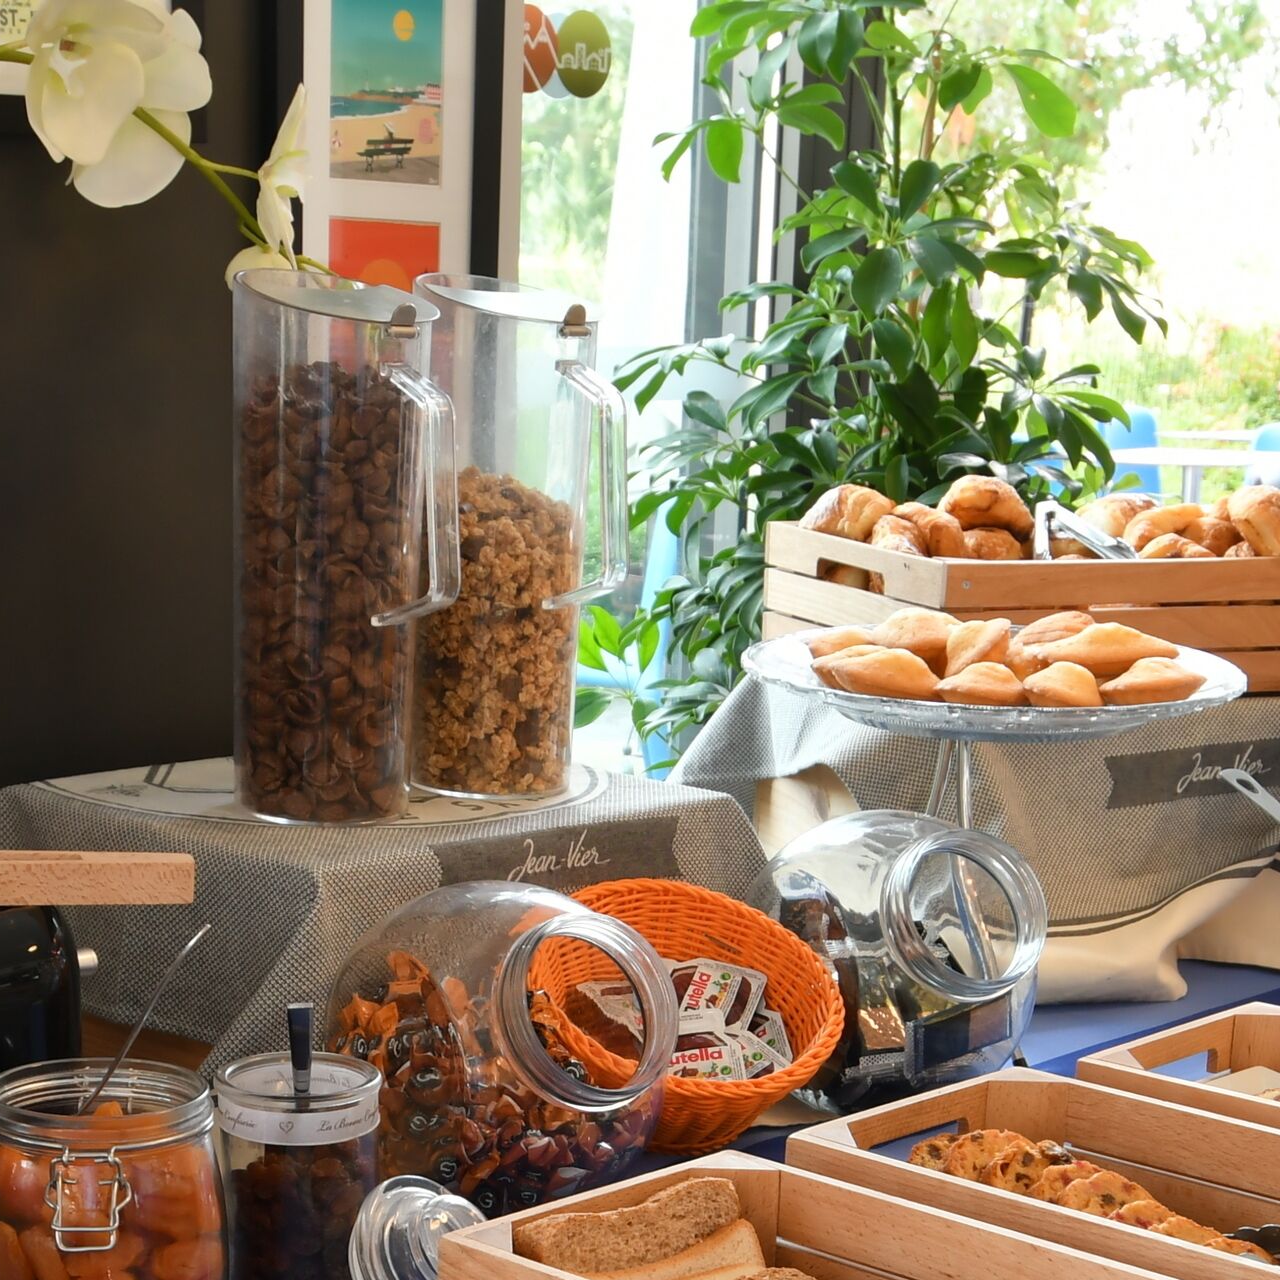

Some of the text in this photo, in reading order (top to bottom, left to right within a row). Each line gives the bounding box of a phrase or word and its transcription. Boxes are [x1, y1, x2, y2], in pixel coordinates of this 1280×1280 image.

[0, 8, 34, 27] ST-
[1177, 744, 1271, 793] JeanVier
[669, 1048, 723, 1066] utella
